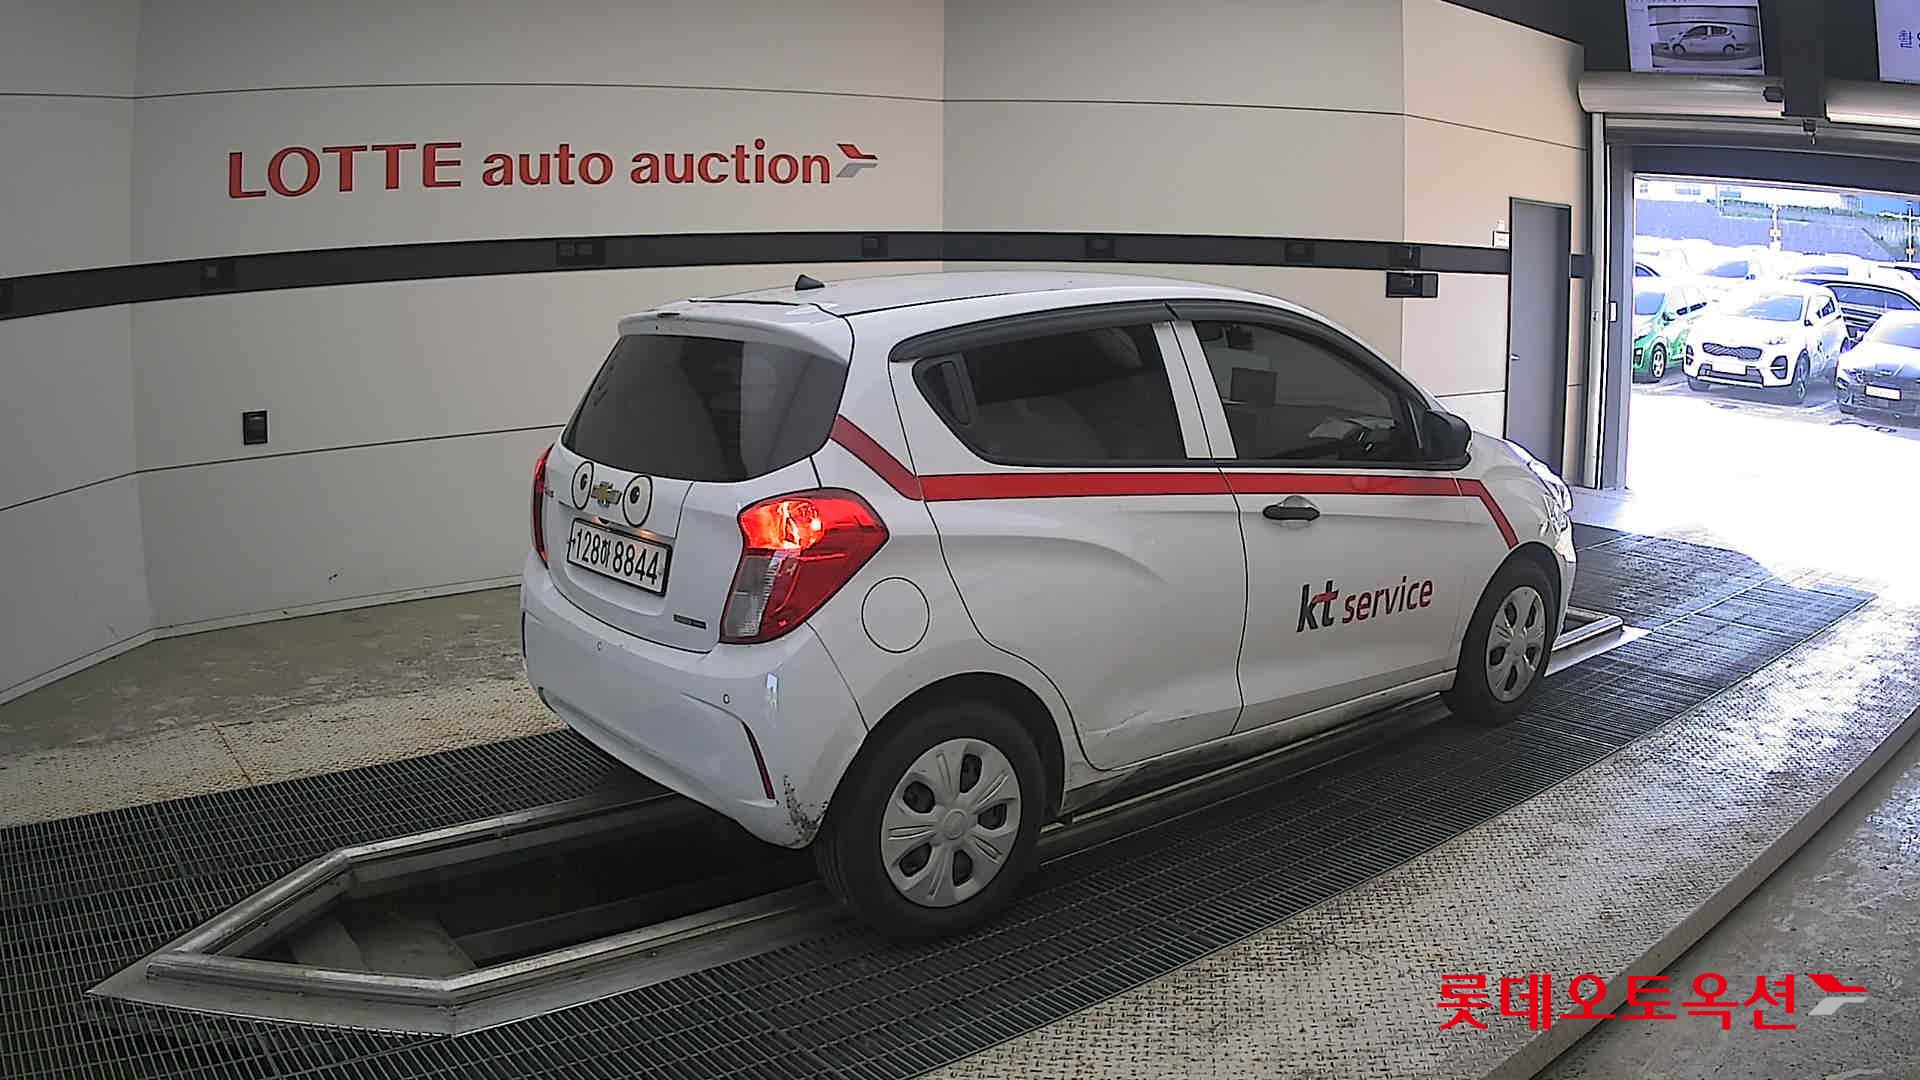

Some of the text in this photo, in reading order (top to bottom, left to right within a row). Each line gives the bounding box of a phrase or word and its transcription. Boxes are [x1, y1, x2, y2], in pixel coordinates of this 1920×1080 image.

[228, 138, 831, 199] LOTTE auto auction
[612, 541, 660, 585] 8844
[1296, 575, 1433, 633] kt service
